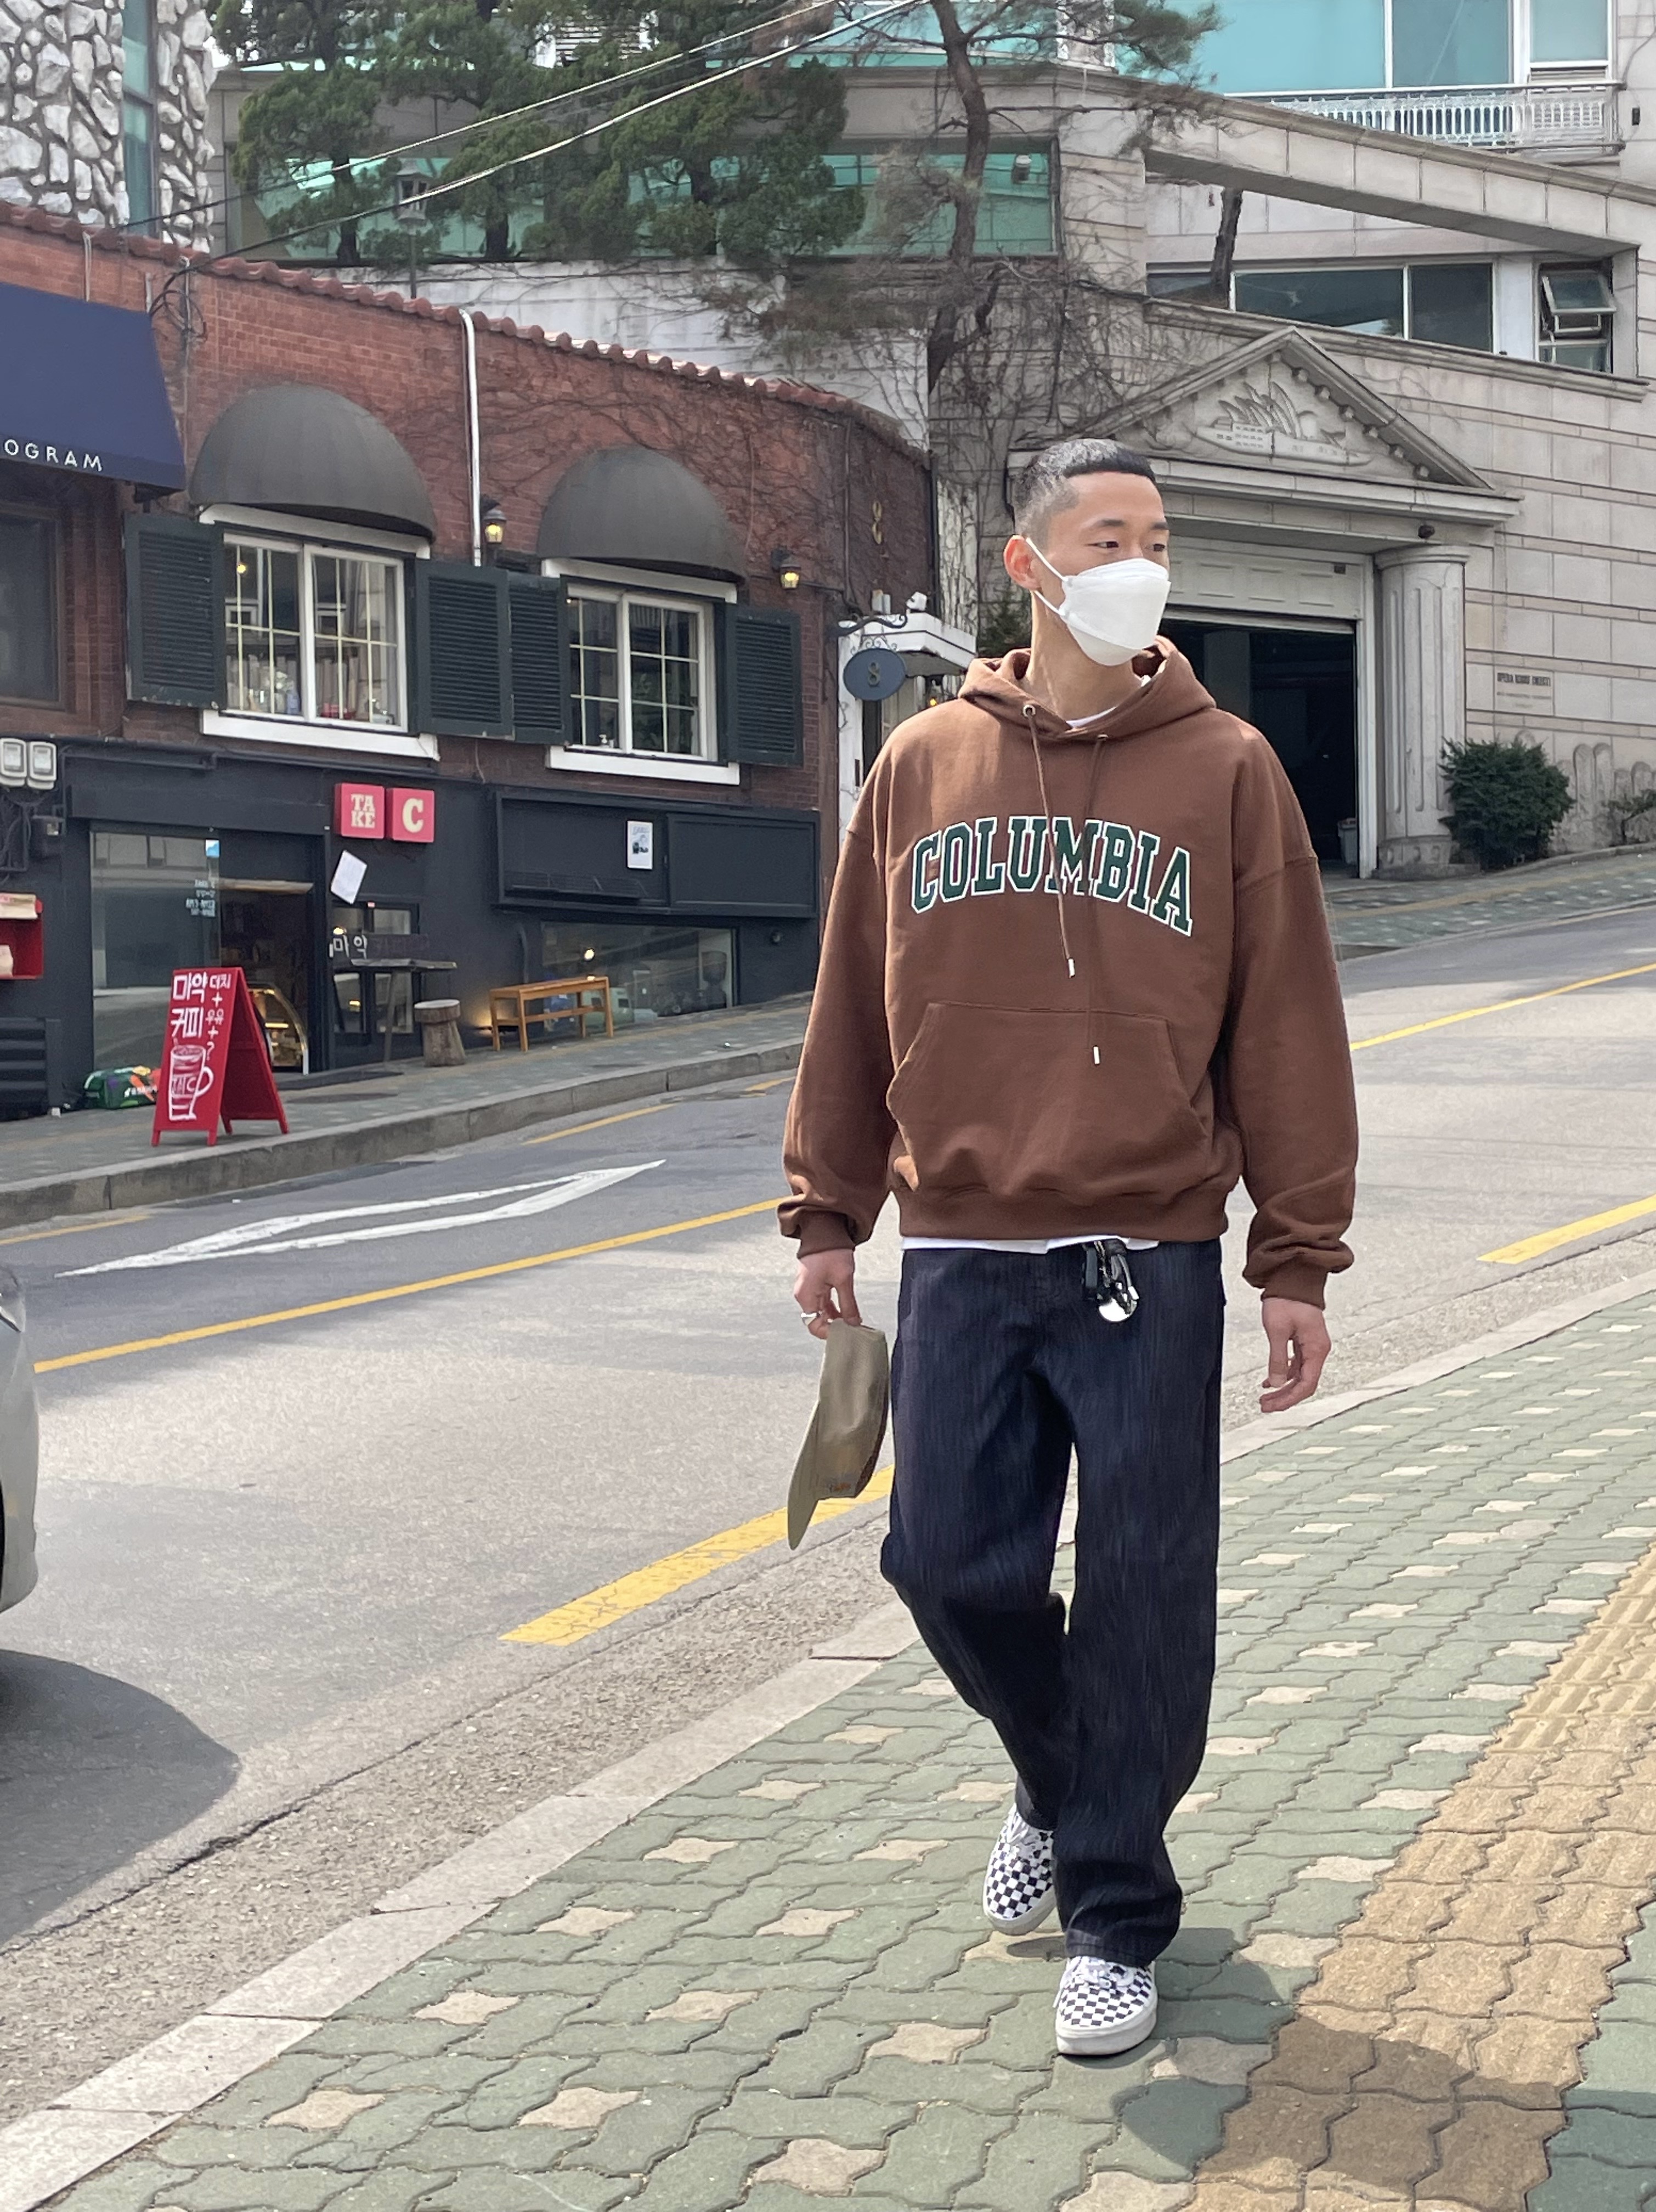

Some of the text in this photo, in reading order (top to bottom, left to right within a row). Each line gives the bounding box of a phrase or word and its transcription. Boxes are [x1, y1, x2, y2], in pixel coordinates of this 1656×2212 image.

[4, 439, 103, 471] OGRAM
[403, 798, 424, 833] C
[912, 816, 1192, 936] COLUMBIA
[173, 972, 207, 1003] 마약
[171, 1007, 204, 1038] 커피
